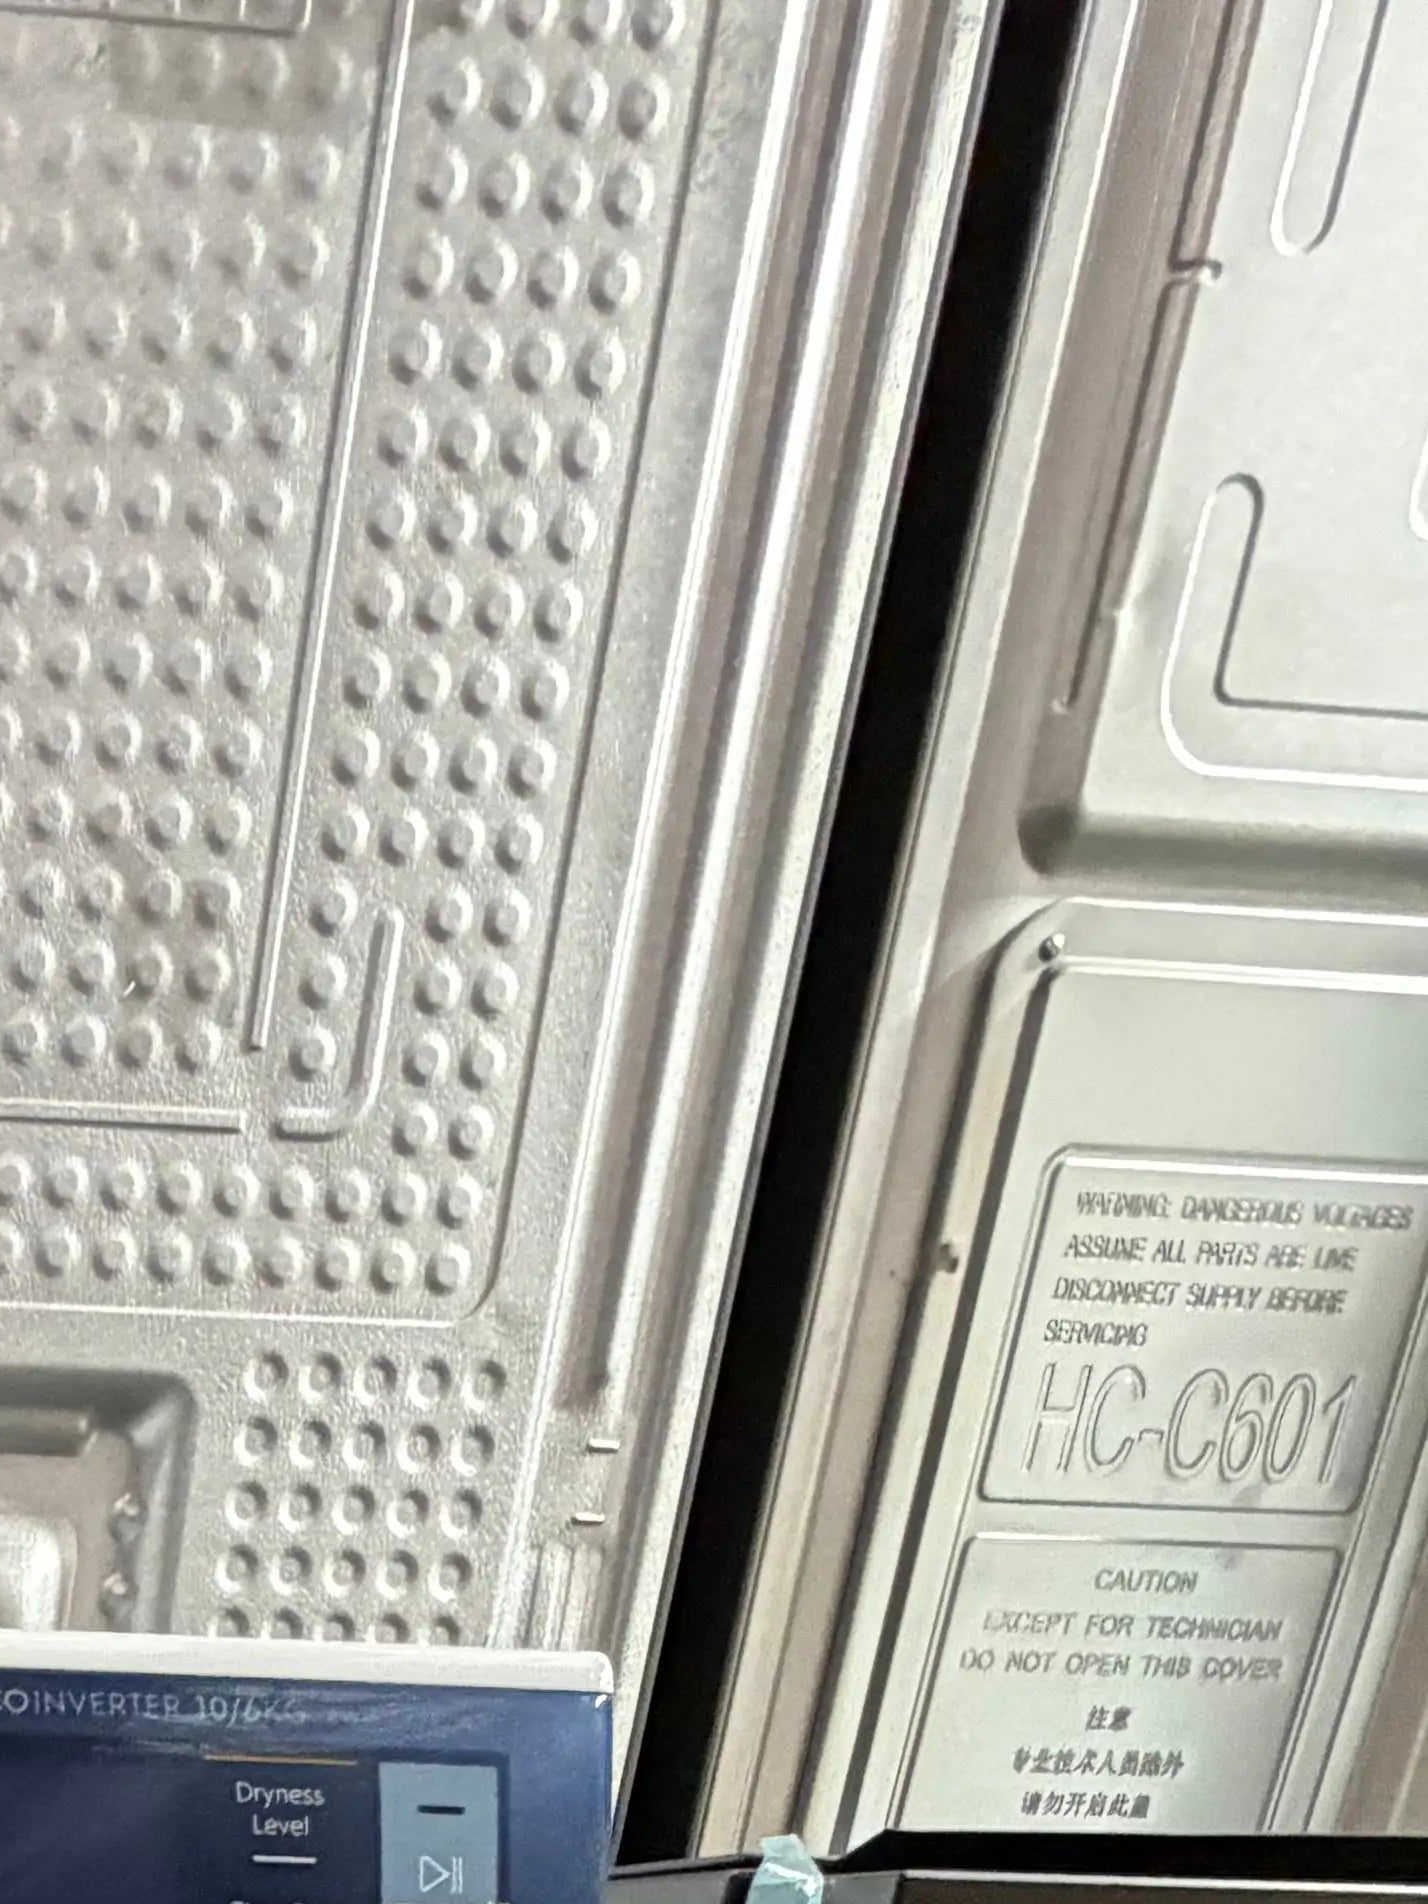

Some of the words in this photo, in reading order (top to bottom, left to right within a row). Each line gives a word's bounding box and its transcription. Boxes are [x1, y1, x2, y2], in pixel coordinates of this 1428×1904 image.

[1180, 1195, 1305, 1225] DANGEROUS
[1312, 1201, 1414, 1231] VOLTAGES
[1064, 1233, 1147, 1261] ASSUME
[1151, 1238, 1187, 1265] ALL
[1195, 1241, 1259, 1267] PARTS
[1263, 1243, 1309, 1270] ARE
[1312, 1246, 1359, 1273] LIVE
[1051, 1277, 1180, 1309] DISCONNECT
[1184, 1282, 1263, 1311] SUPPLY
[1265, 1286, 1349, 1315] BEFORE
[1022, 1361, 1359, 1486] HC-C601
[1094, 1567, 1198, 1593] CAUTION
[982, 1608, 1077, 1636] EXCEPT
[1083, 1613, 1136, 1638] FOR
[1145, 1615, 1284, 1643] TECHNICIAN
[958, 1648, 996, 1672] DO
[1004, 1650, 1058, 1674] NOT
[1064, 1652, 1132, 1678] OPEN
[1141, 1654, 1192, 1680] THIS
[1200, 1655, 1284, 1683] COVER
[235, 1781, 326, 1809] Dryness
[252, 1814, 309, 1837] Level
